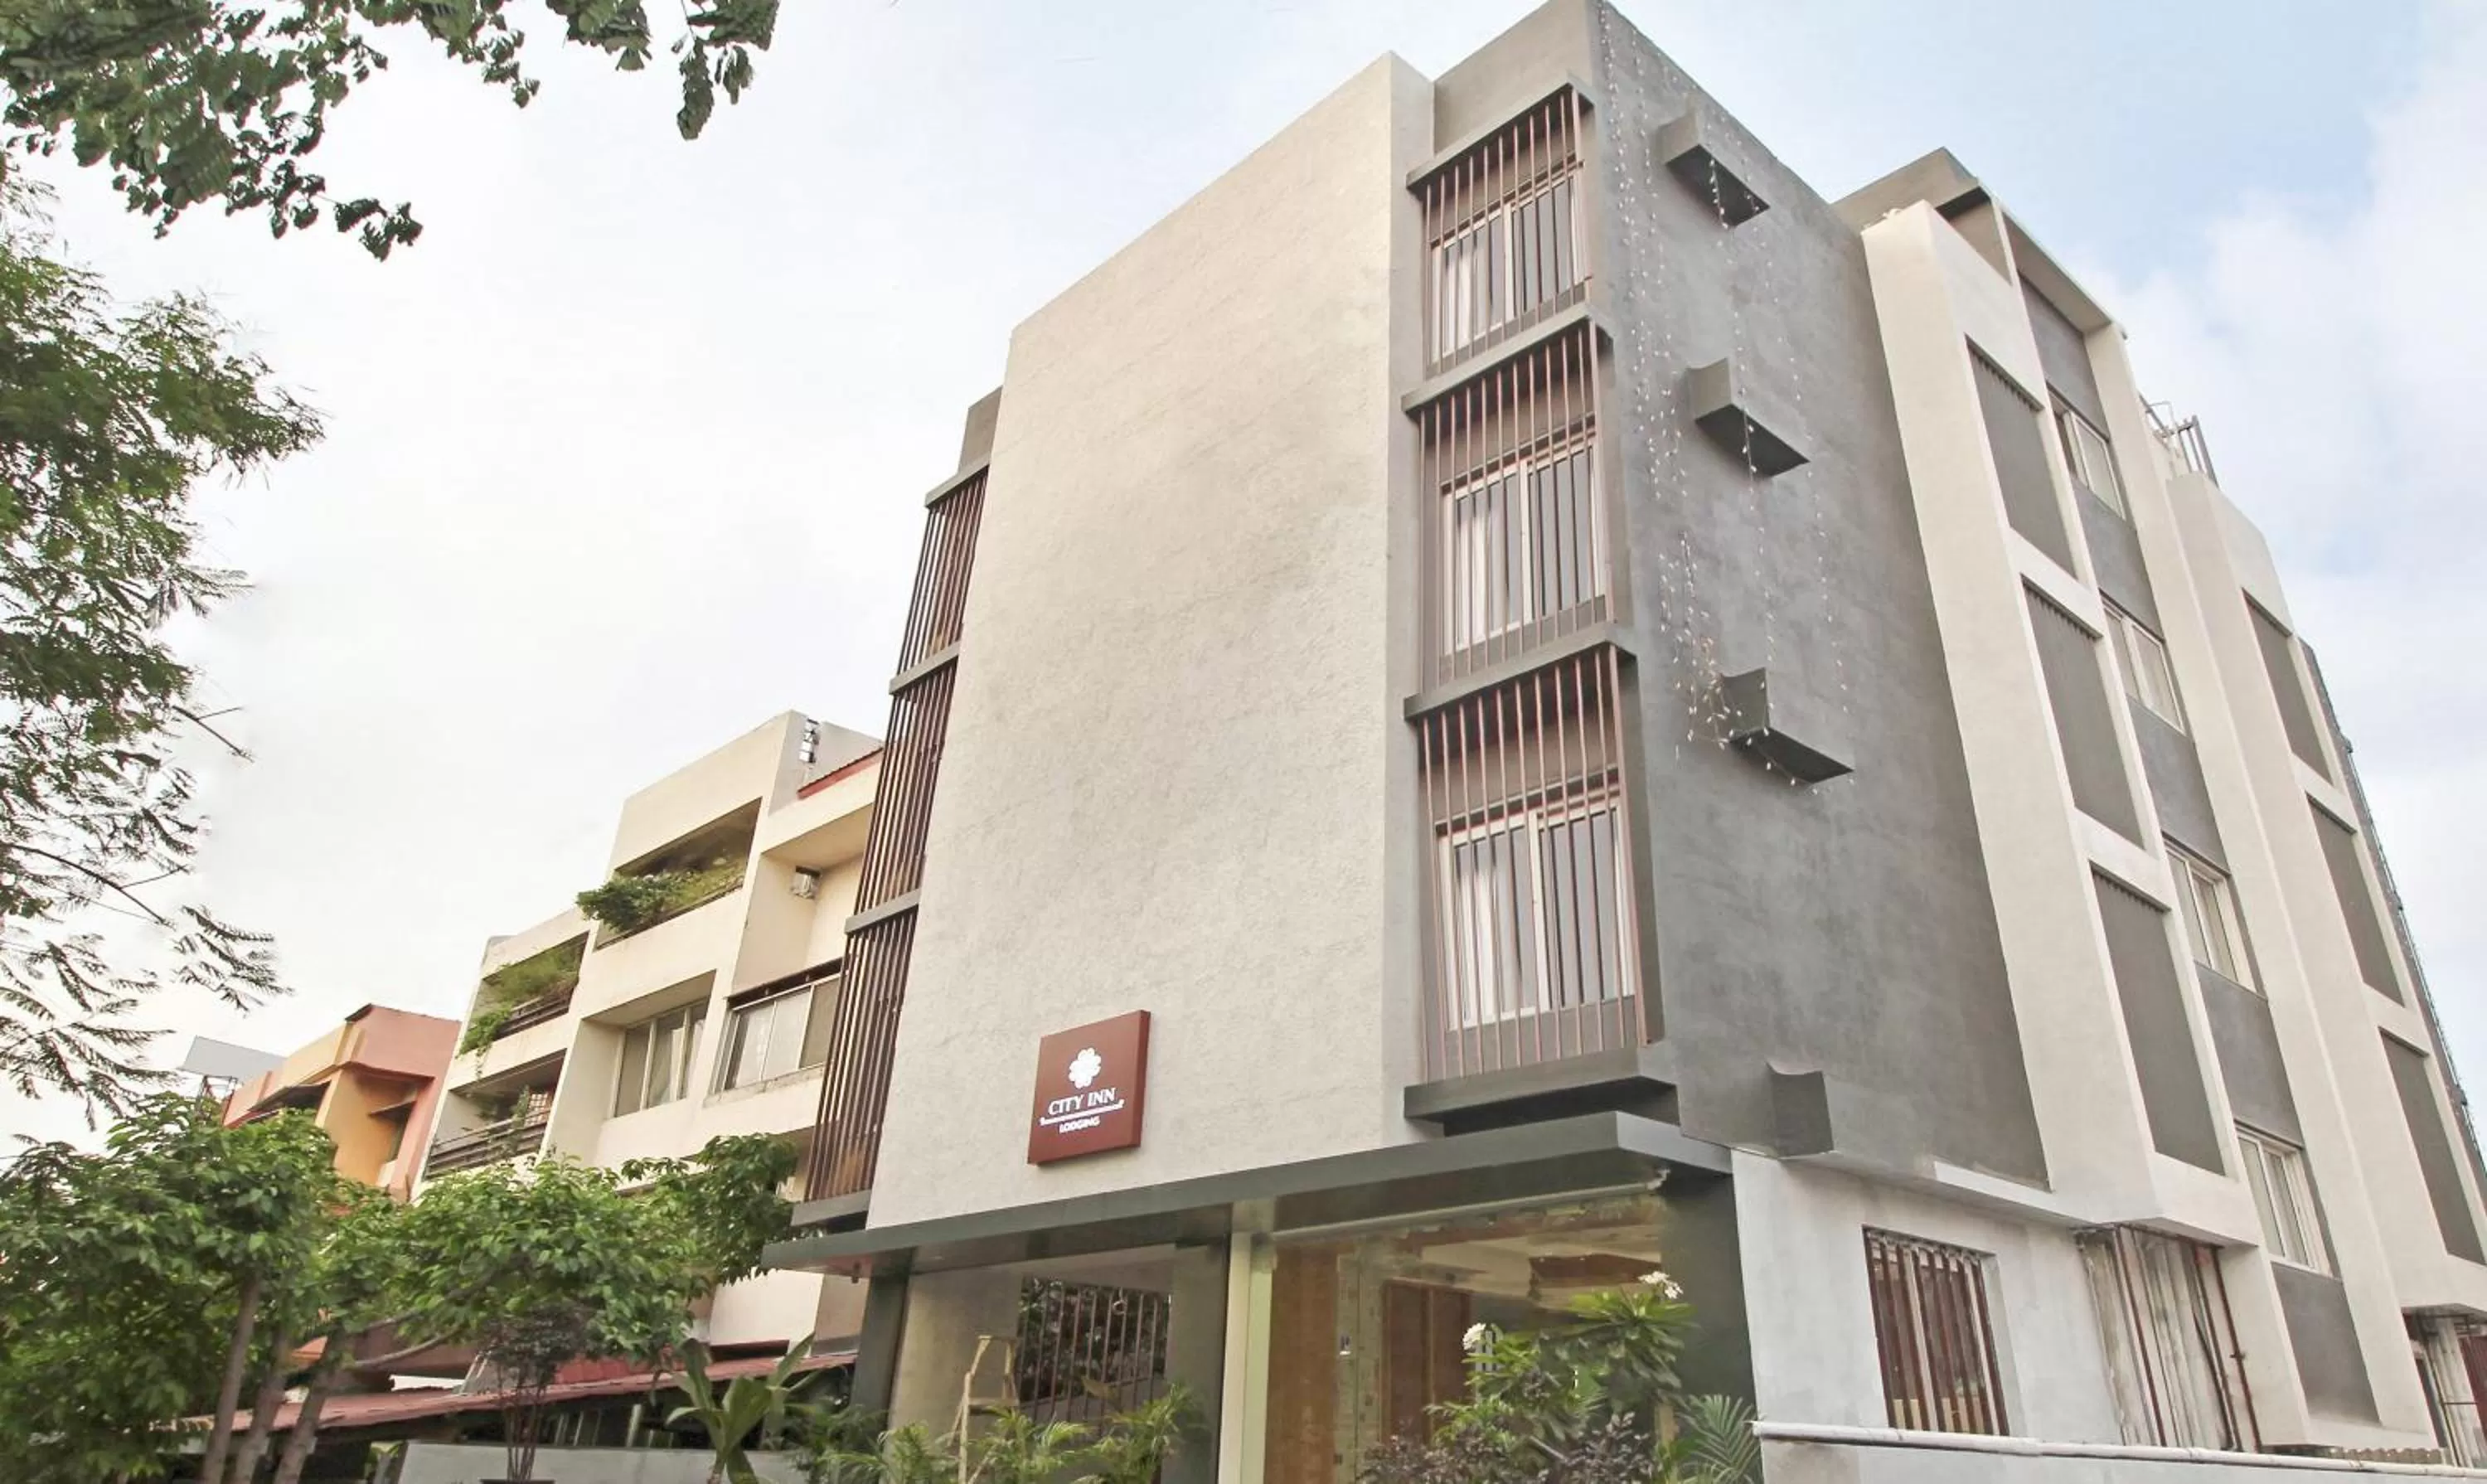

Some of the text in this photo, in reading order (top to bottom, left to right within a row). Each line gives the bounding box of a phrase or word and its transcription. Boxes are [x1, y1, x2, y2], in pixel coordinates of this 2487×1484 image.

[1048, 1087, 1117, 1115] CITY INN
[1059, 1116, 1101, 1134] LODGING
